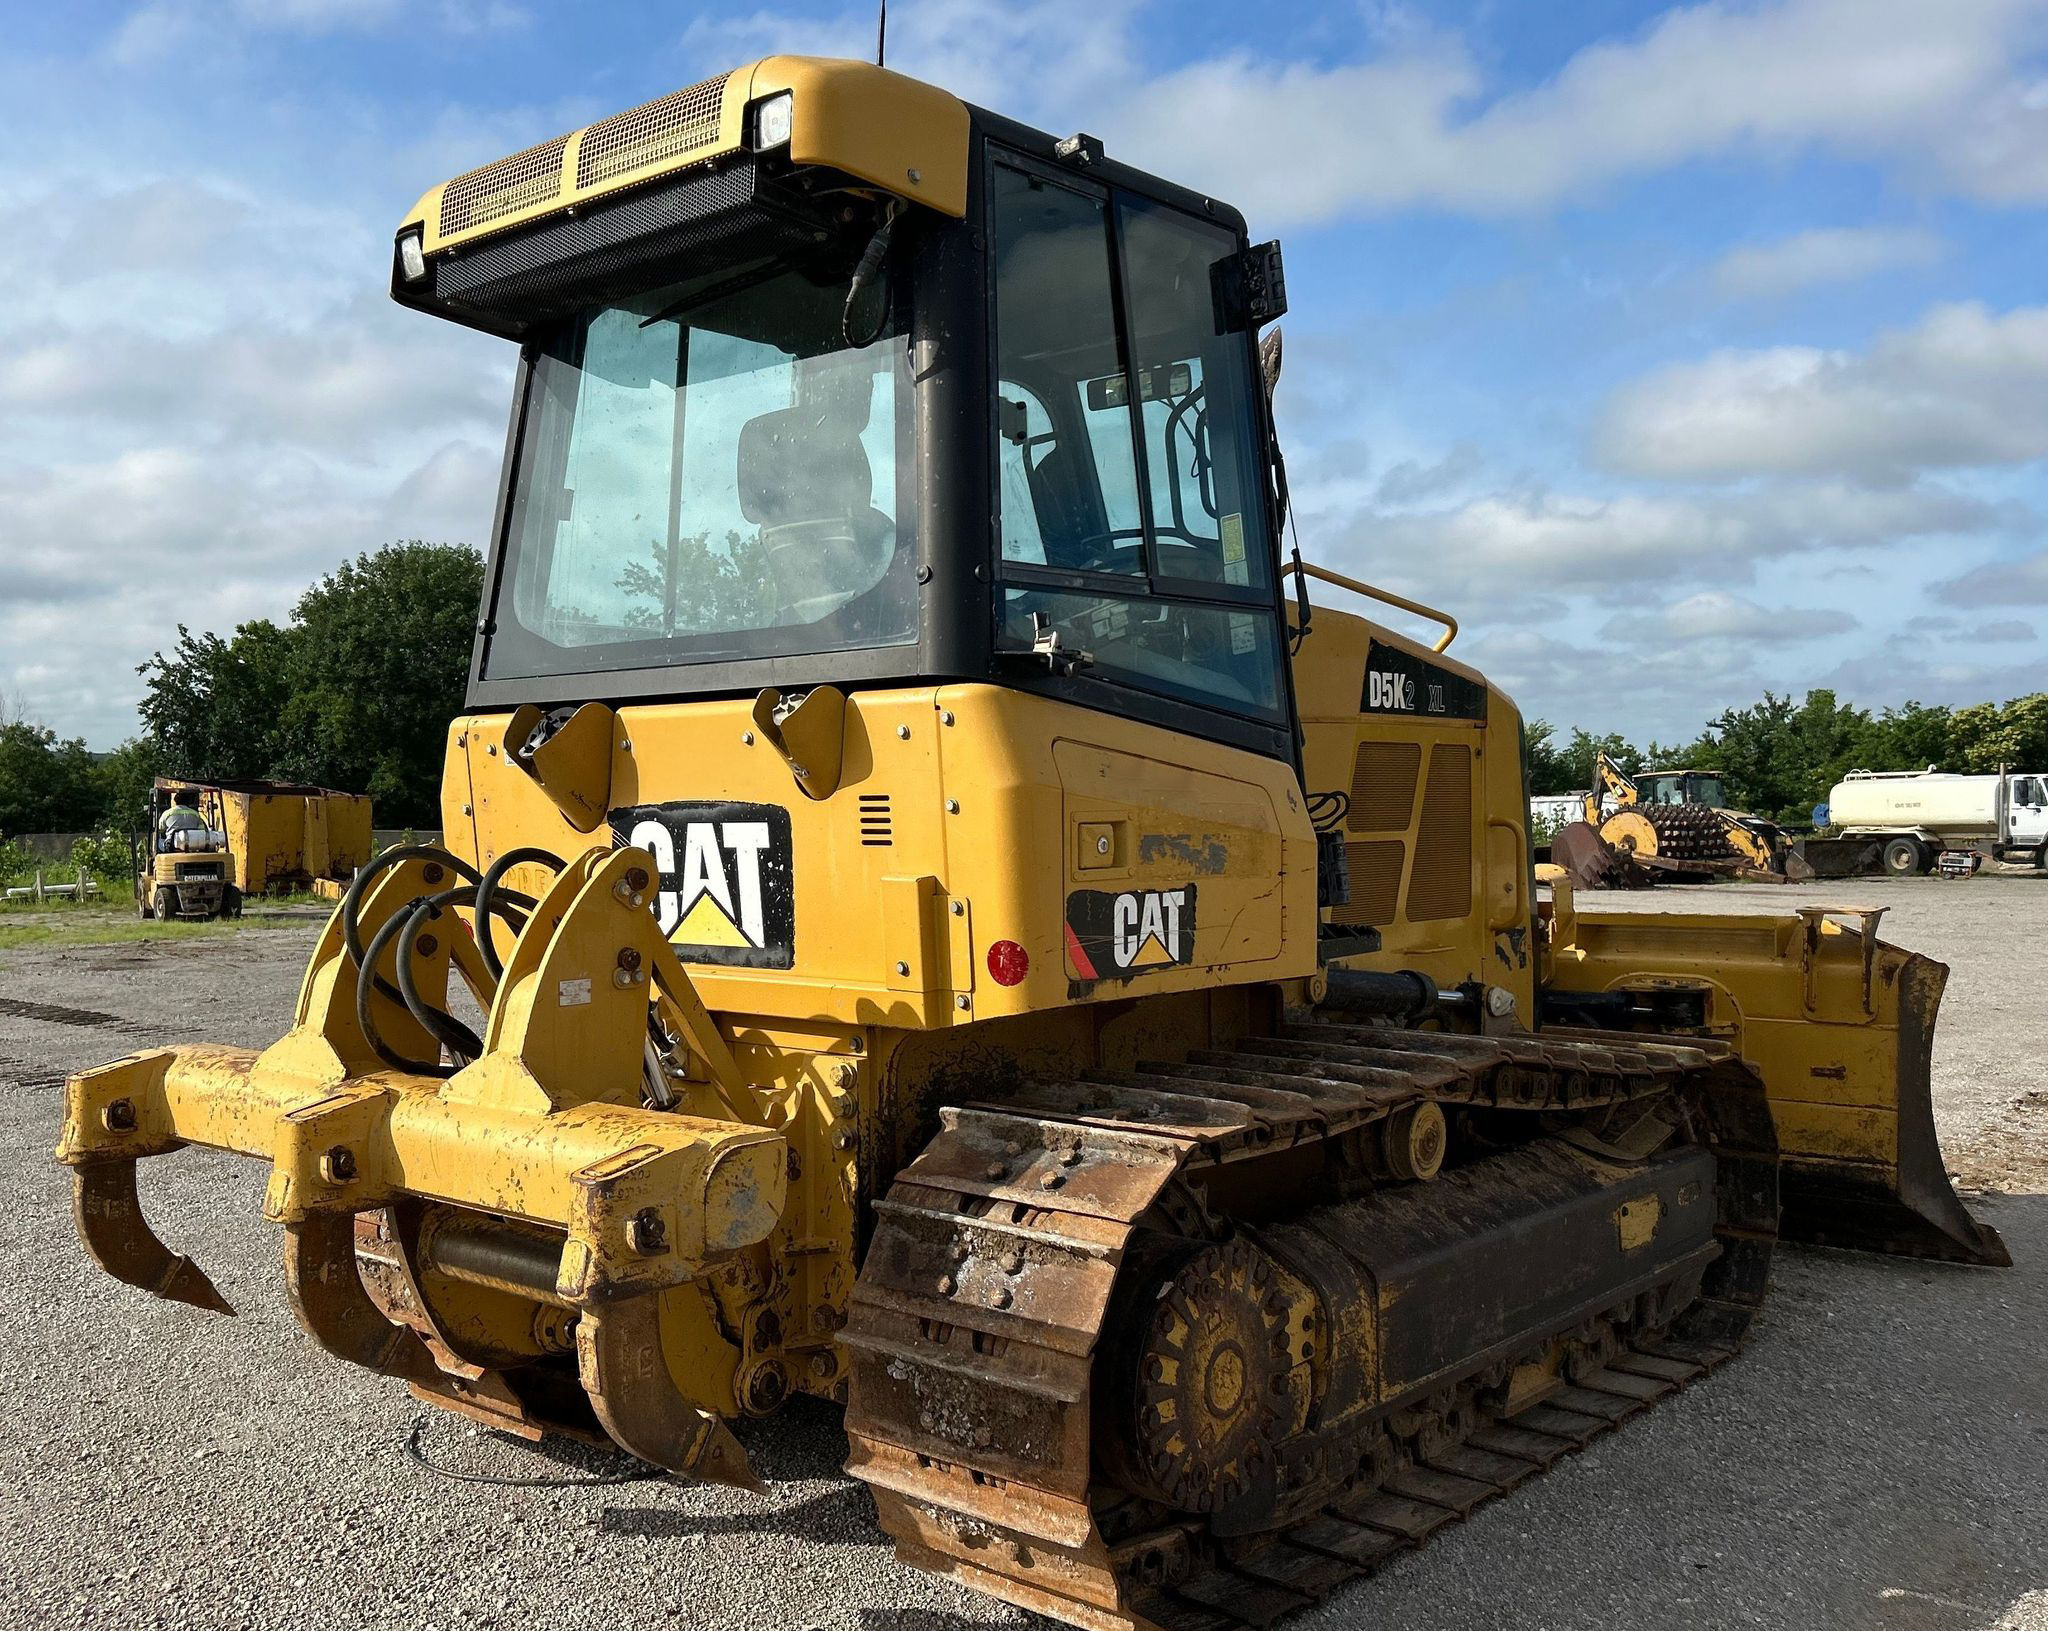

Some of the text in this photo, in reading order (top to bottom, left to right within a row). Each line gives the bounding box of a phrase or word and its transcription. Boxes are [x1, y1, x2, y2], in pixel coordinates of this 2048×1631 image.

[1428, 684, 1445, 712] XL
[630, 820, 770, 949] CAT
[1113, 891, 1185, 968] CAT
